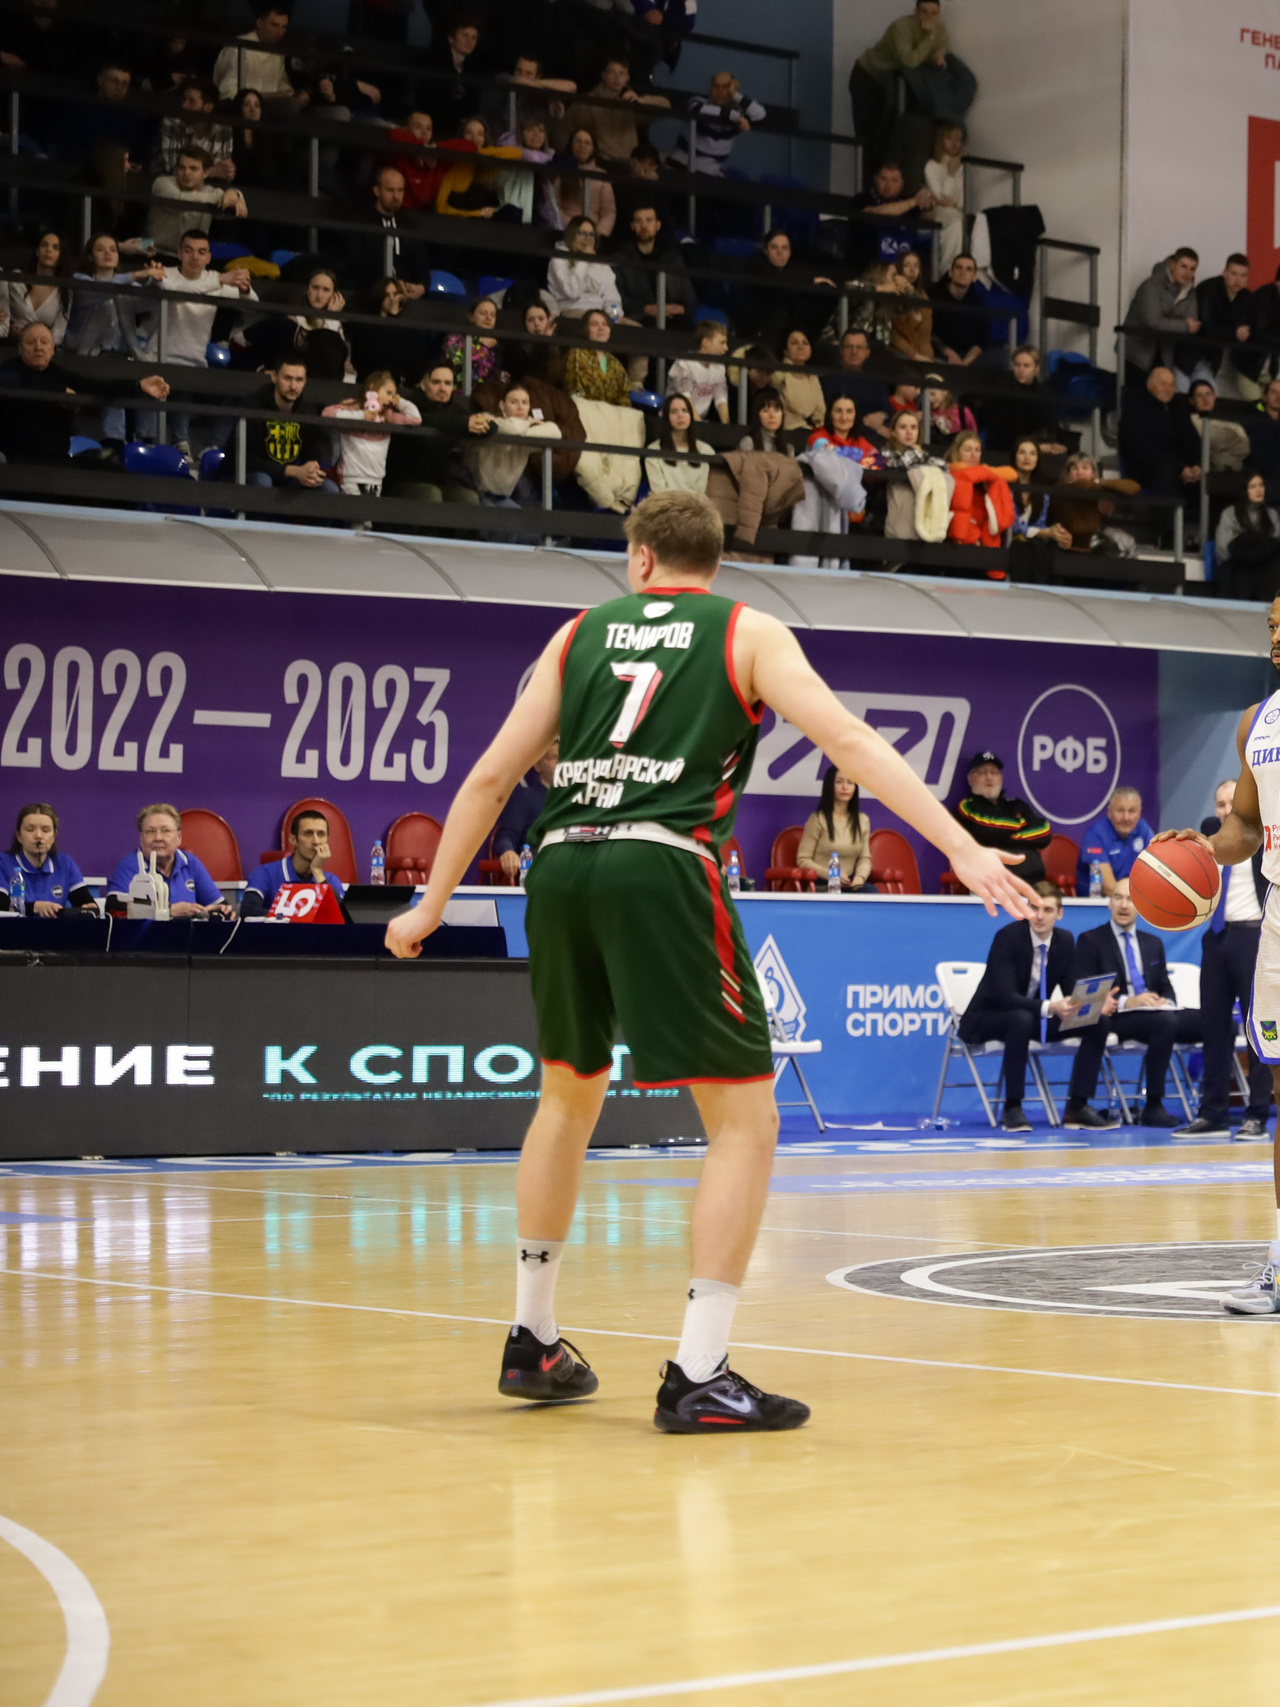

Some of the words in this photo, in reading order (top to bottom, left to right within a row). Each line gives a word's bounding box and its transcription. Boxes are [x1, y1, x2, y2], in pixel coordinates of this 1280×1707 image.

[605, 622, 694, 650] ТЕМИРОВ
[609, 661, 664, 748] 7
[1033, 734, 1108, 775] РФБ
[846, 984, 945, 1009] ПРИМО
[845, 1012, 952, 1037] СПОРТИ
[0, 1046, 214, 1087] НИЕ
[264, 1046, 318, 1084] К
